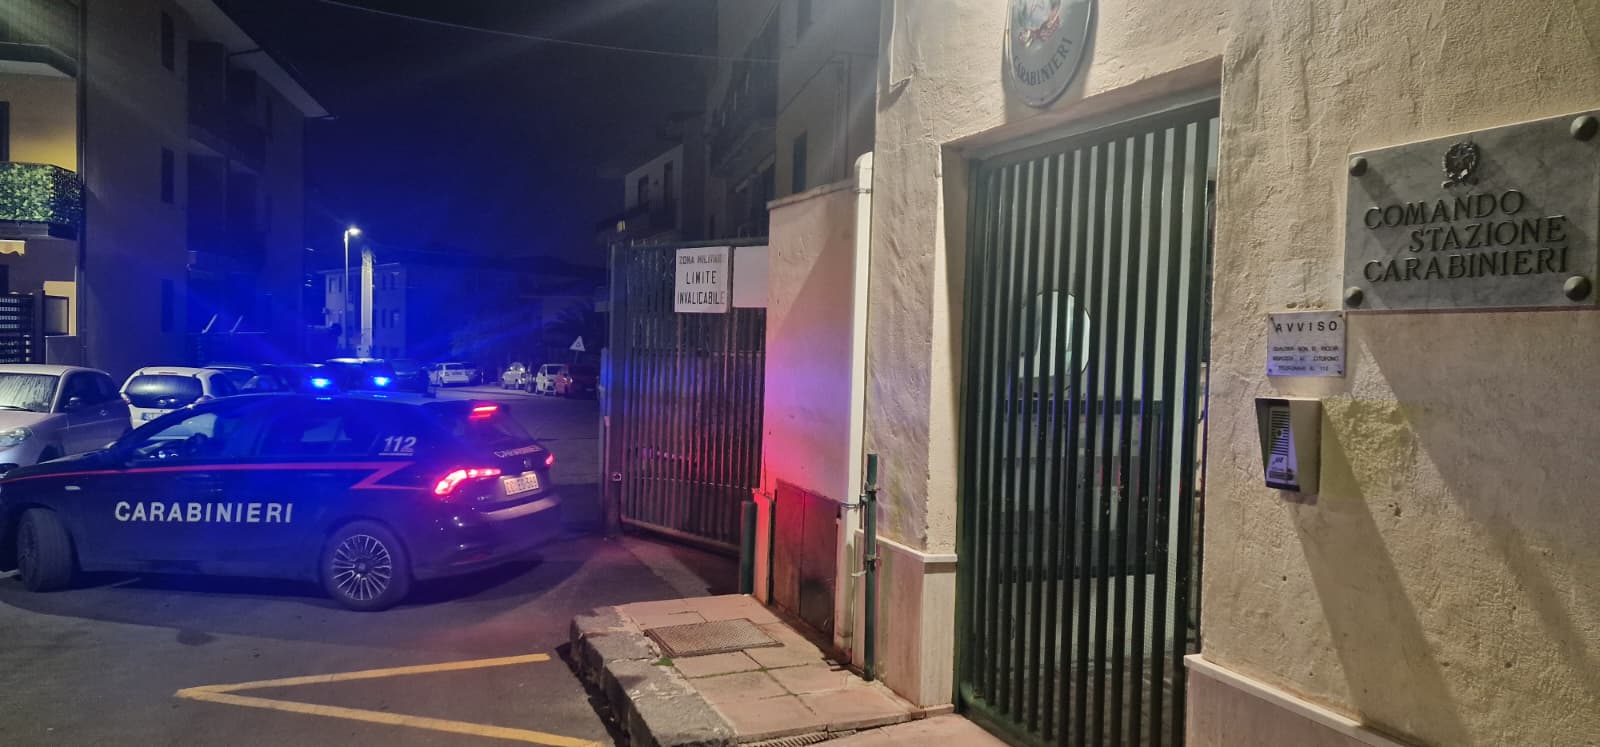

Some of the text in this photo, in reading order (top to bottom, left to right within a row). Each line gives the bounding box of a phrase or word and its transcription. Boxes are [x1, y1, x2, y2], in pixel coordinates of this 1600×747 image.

[1013, 37, 1073, 86] CARABINIERI
[1364, 189, 1525, 229] COMANDO
[1409, 215, 1567, 252] STAZIONE
[679, 255, 695, 265] ZONA
[1363, 247, 1568, 282] CARABINIERI
[686, 270, 717, 285] LIMITE
[677, 290, 726, 305] INVALICABILE
[1274, 320, 1338, 333] AVVISO
[383, 435, 418, 453] 112
[114, 501, 294, 524] CARABINIERI
